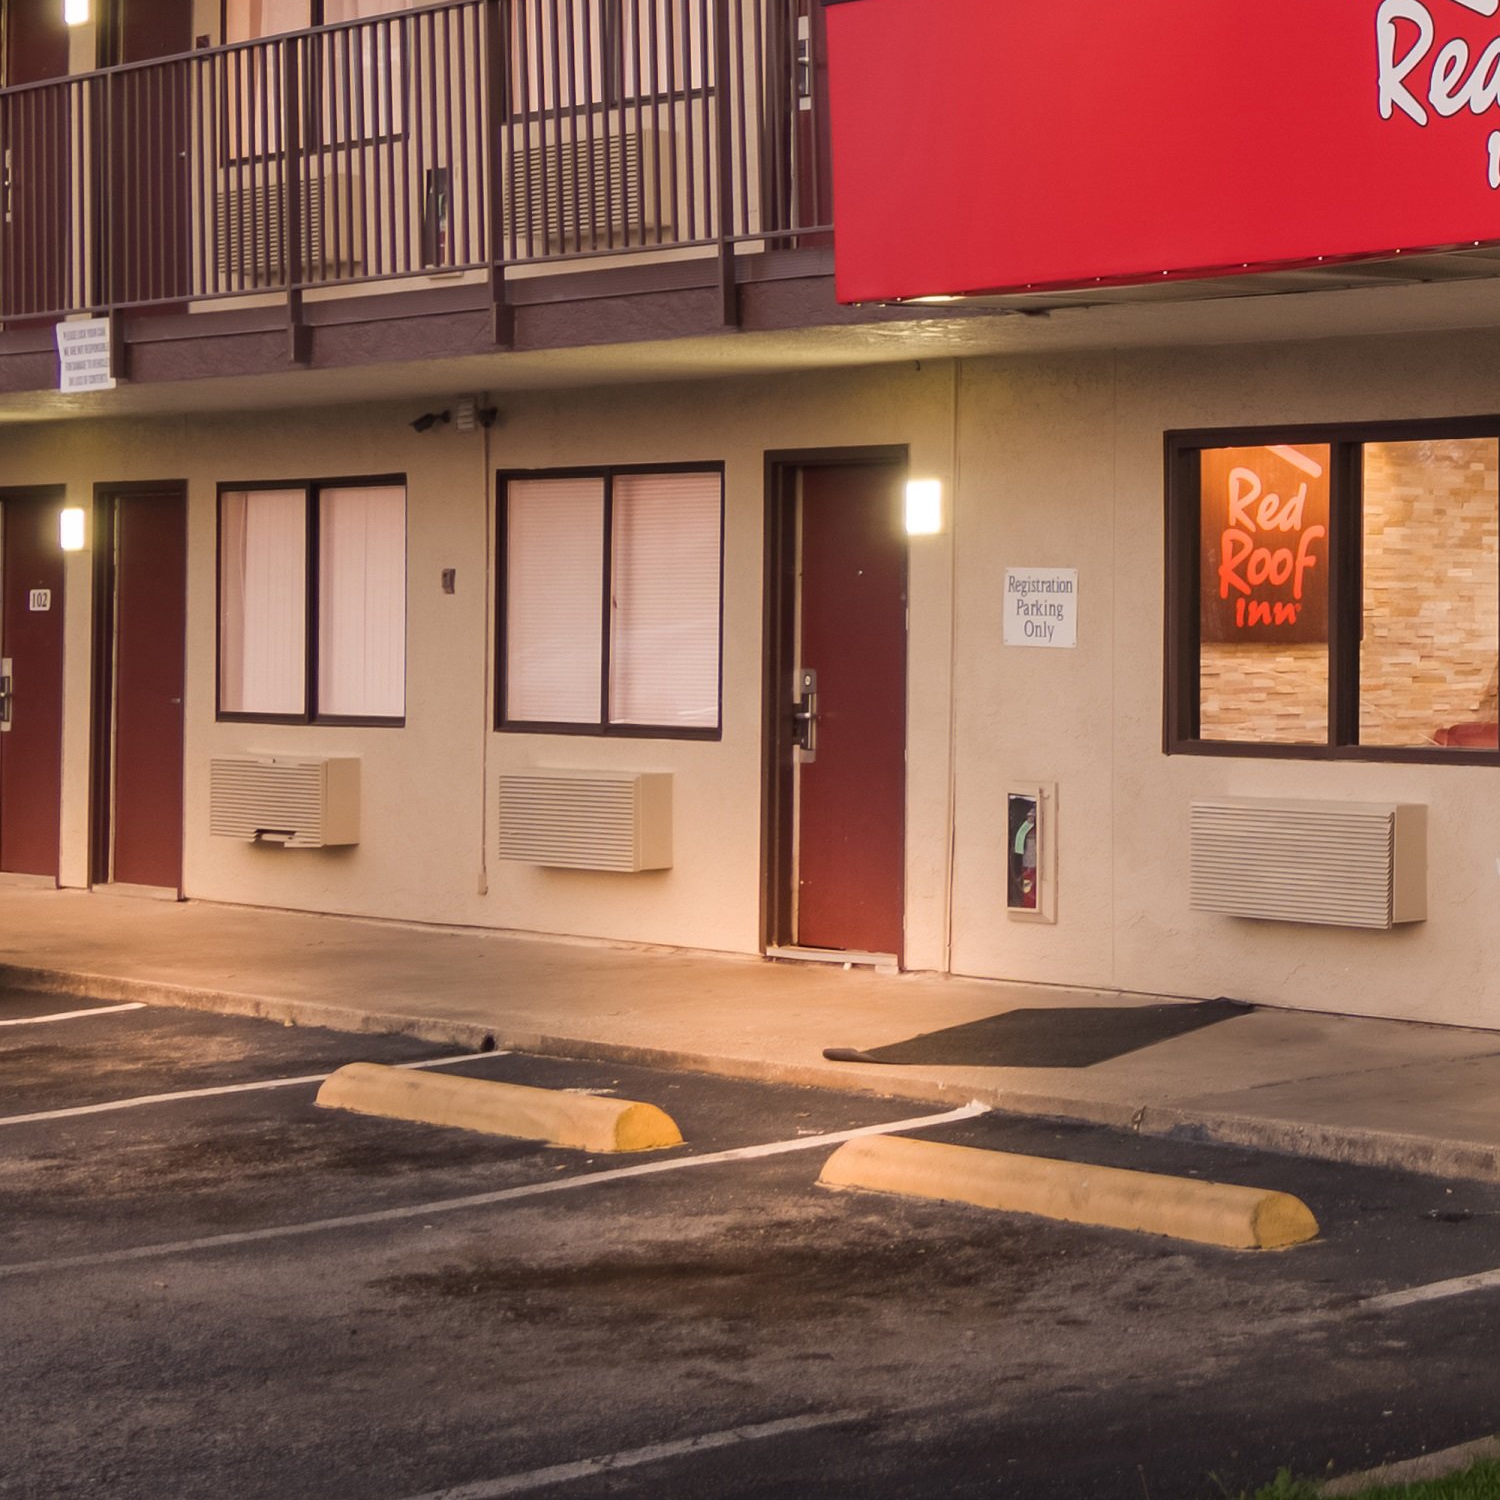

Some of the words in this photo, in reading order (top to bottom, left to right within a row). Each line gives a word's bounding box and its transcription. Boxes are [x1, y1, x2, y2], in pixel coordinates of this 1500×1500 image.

[1228, 467, 1307, 533] Red
[1218, 524, 1325, 599] Roof
[1008, 575, 1073, 597] Registration
[32, 592, 48, 608] 102
[1016, 599, 1064, 621] Parking
[1024, 620, 1055, 643] Only
